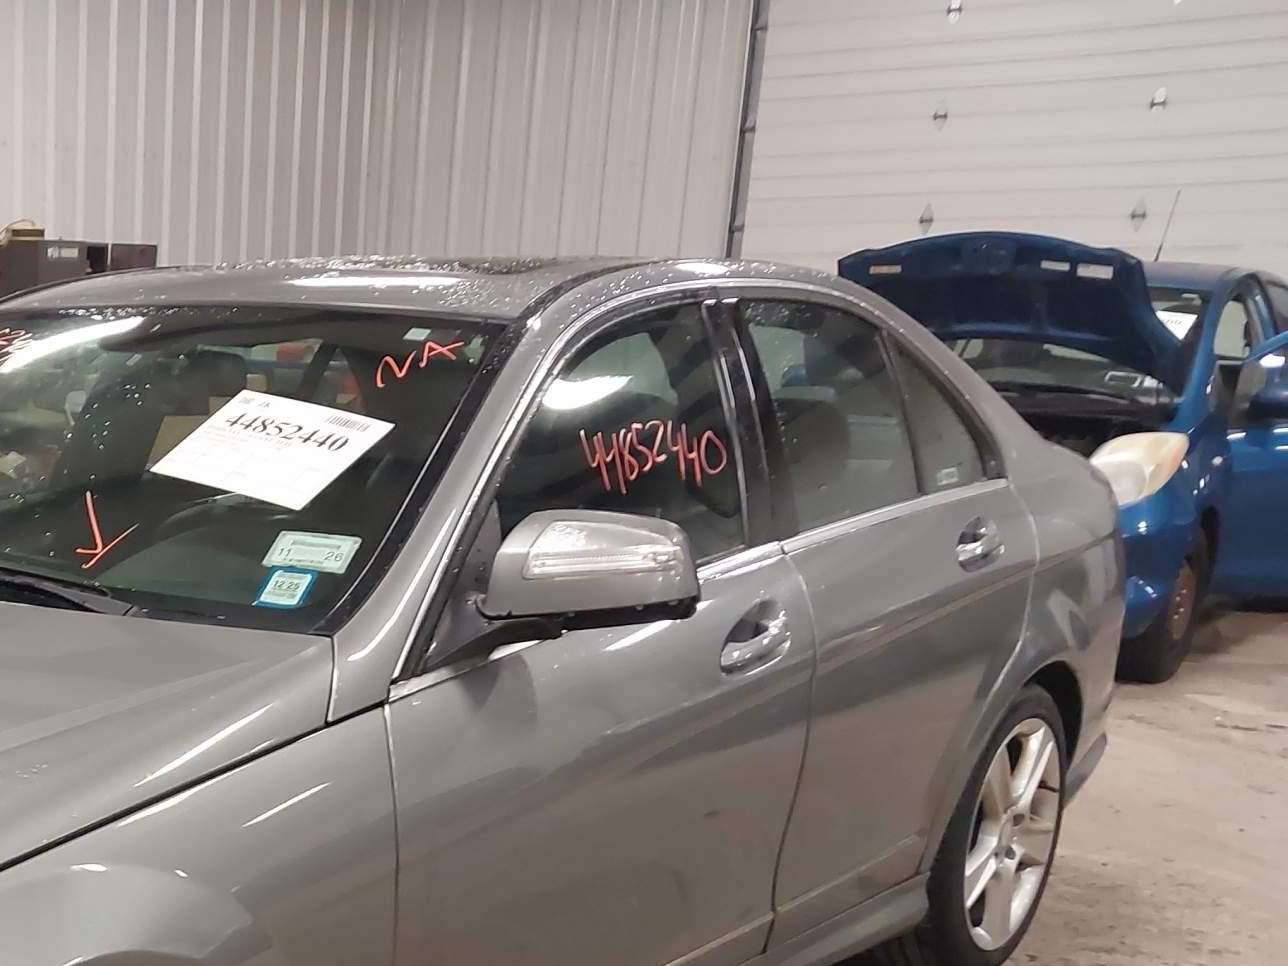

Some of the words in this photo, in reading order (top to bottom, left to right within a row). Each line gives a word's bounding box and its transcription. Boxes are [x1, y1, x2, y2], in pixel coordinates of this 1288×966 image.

[225, 412, 349, 451] 44852440
[579, 420, 728, 495] 44852440
[323, 552, 344, 562] 26
